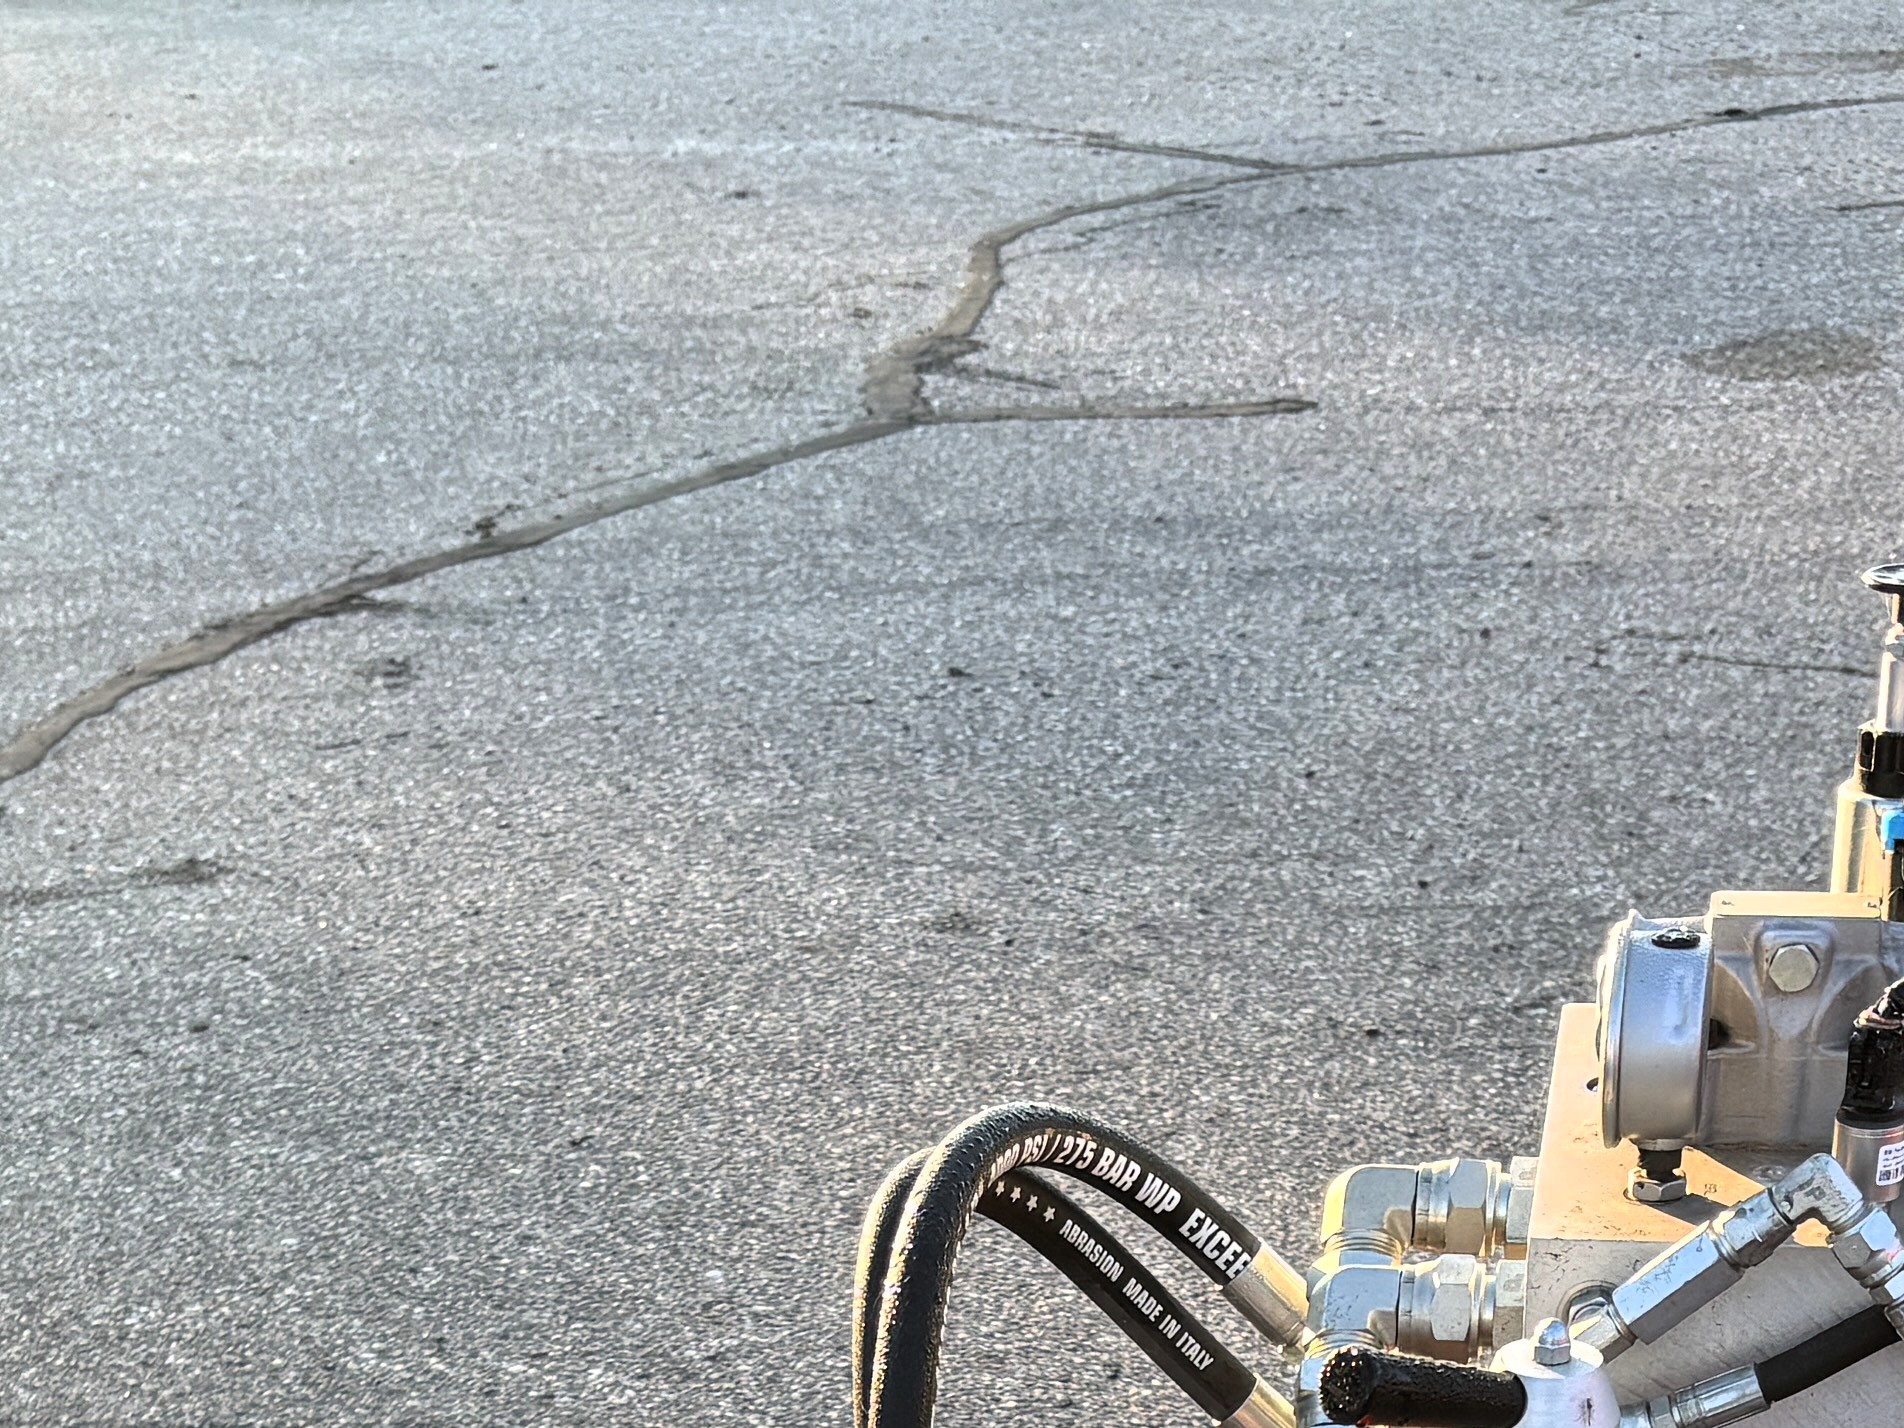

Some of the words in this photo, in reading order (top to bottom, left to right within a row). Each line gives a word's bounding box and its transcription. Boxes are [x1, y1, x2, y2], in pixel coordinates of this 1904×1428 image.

[1056, 1135, 1098, 1170] 275
[1091, 1147, 1142, 1192] BAR
[1134, 1172, 1182, 1215] WP
[1059, 1219, 1124, 1283] ABRASION
[1122, 1277, 1164, 1323] MADE
[1158, 1314, 1181, 1340] IN
[1176, 1332, 1214, 1371] ITALY
